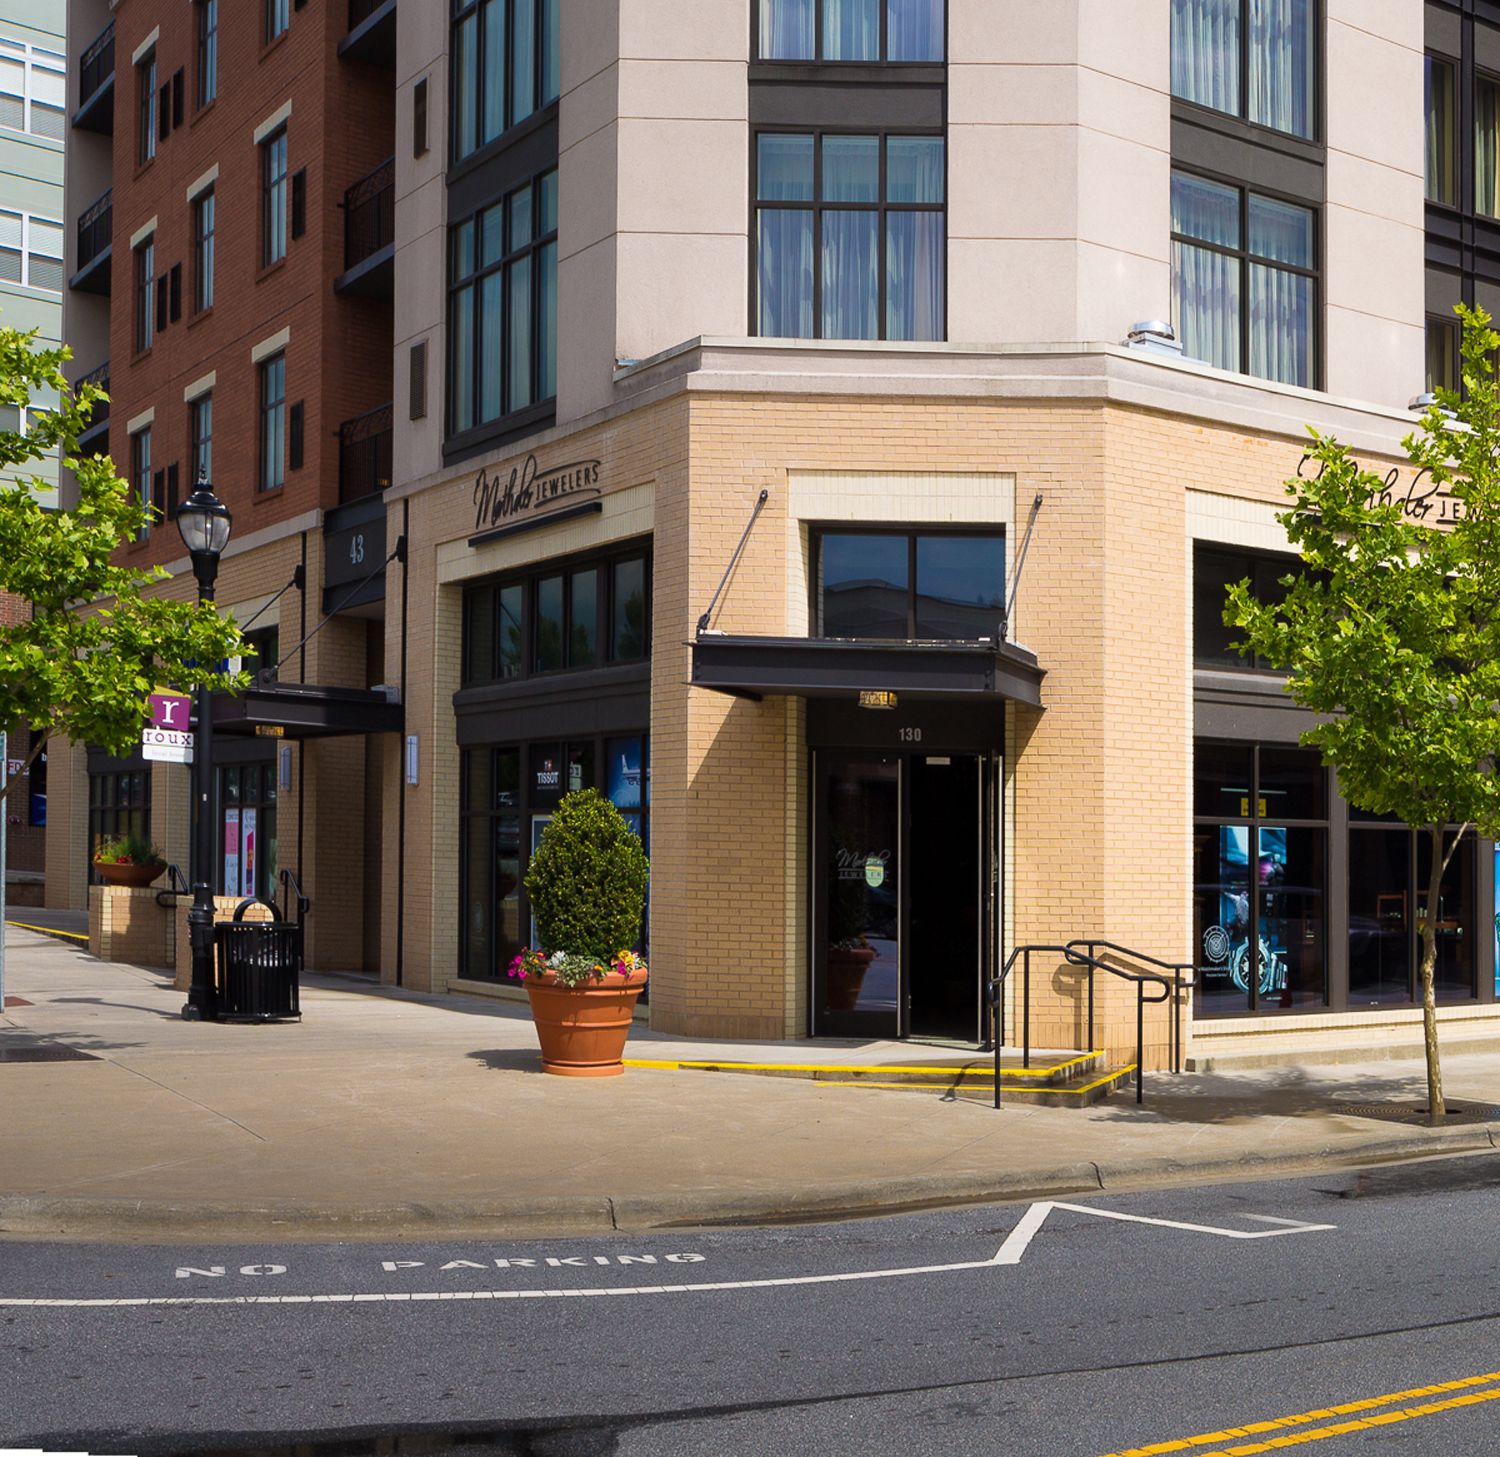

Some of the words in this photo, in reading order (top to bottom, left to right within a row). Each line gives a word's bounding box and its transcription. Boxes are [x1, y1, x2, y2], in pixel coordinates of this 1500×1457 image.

[536, 464, 599, 501] JEWELERS
[350, 534, 364, 564] 43
[162, 700, 179, 724] r
[146, 732, 191, 745] roux
[899, 728, 921, 741] 130
[537, 772, 559, 784] TISSOT
[175, 1264, 287, 1279] NO
[381, 1253, 706, 1271] PARKING
